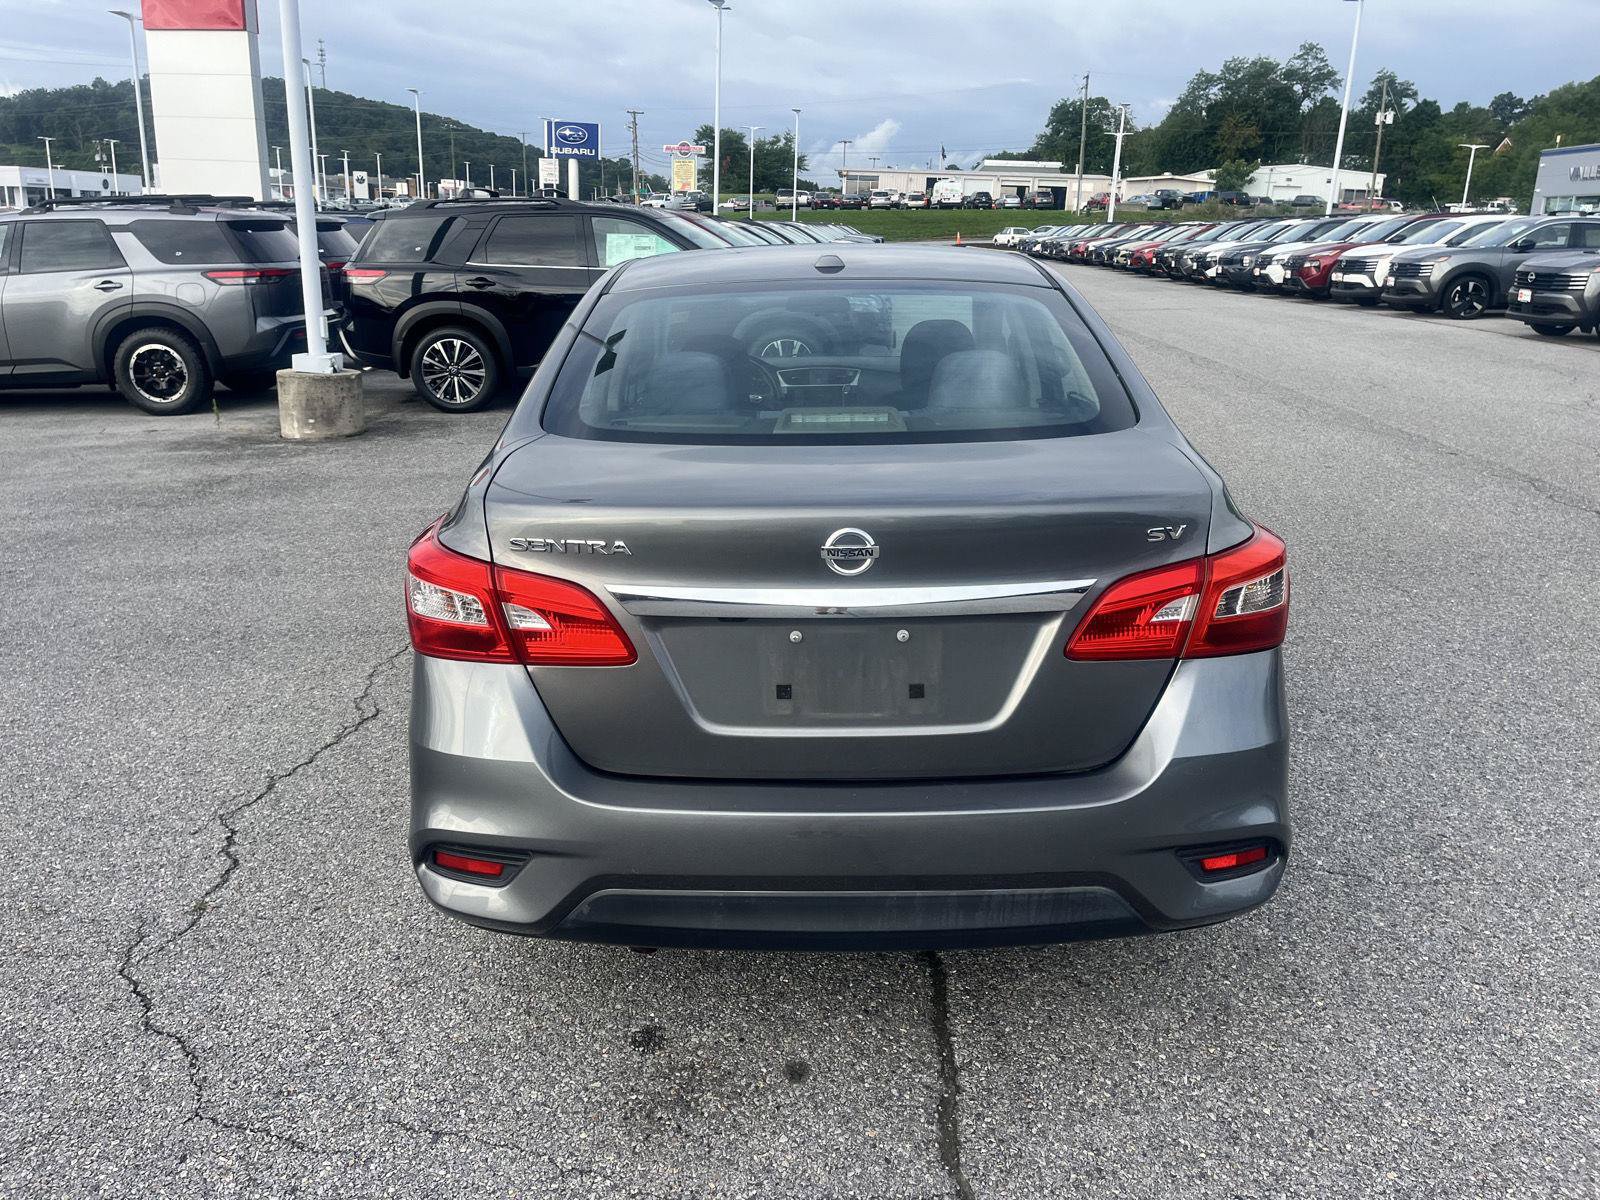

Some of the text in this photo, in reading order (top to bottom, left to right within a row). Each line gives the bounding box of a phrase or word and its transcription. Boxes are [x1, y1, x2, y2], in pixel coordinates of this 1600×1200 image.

[550, 146, 595, 156] SUBARU
[1147, 524, 1187, 541] SV
[509, 537, 632, 555] SENTRA
[826, 547, 874, 557] NISSAN
